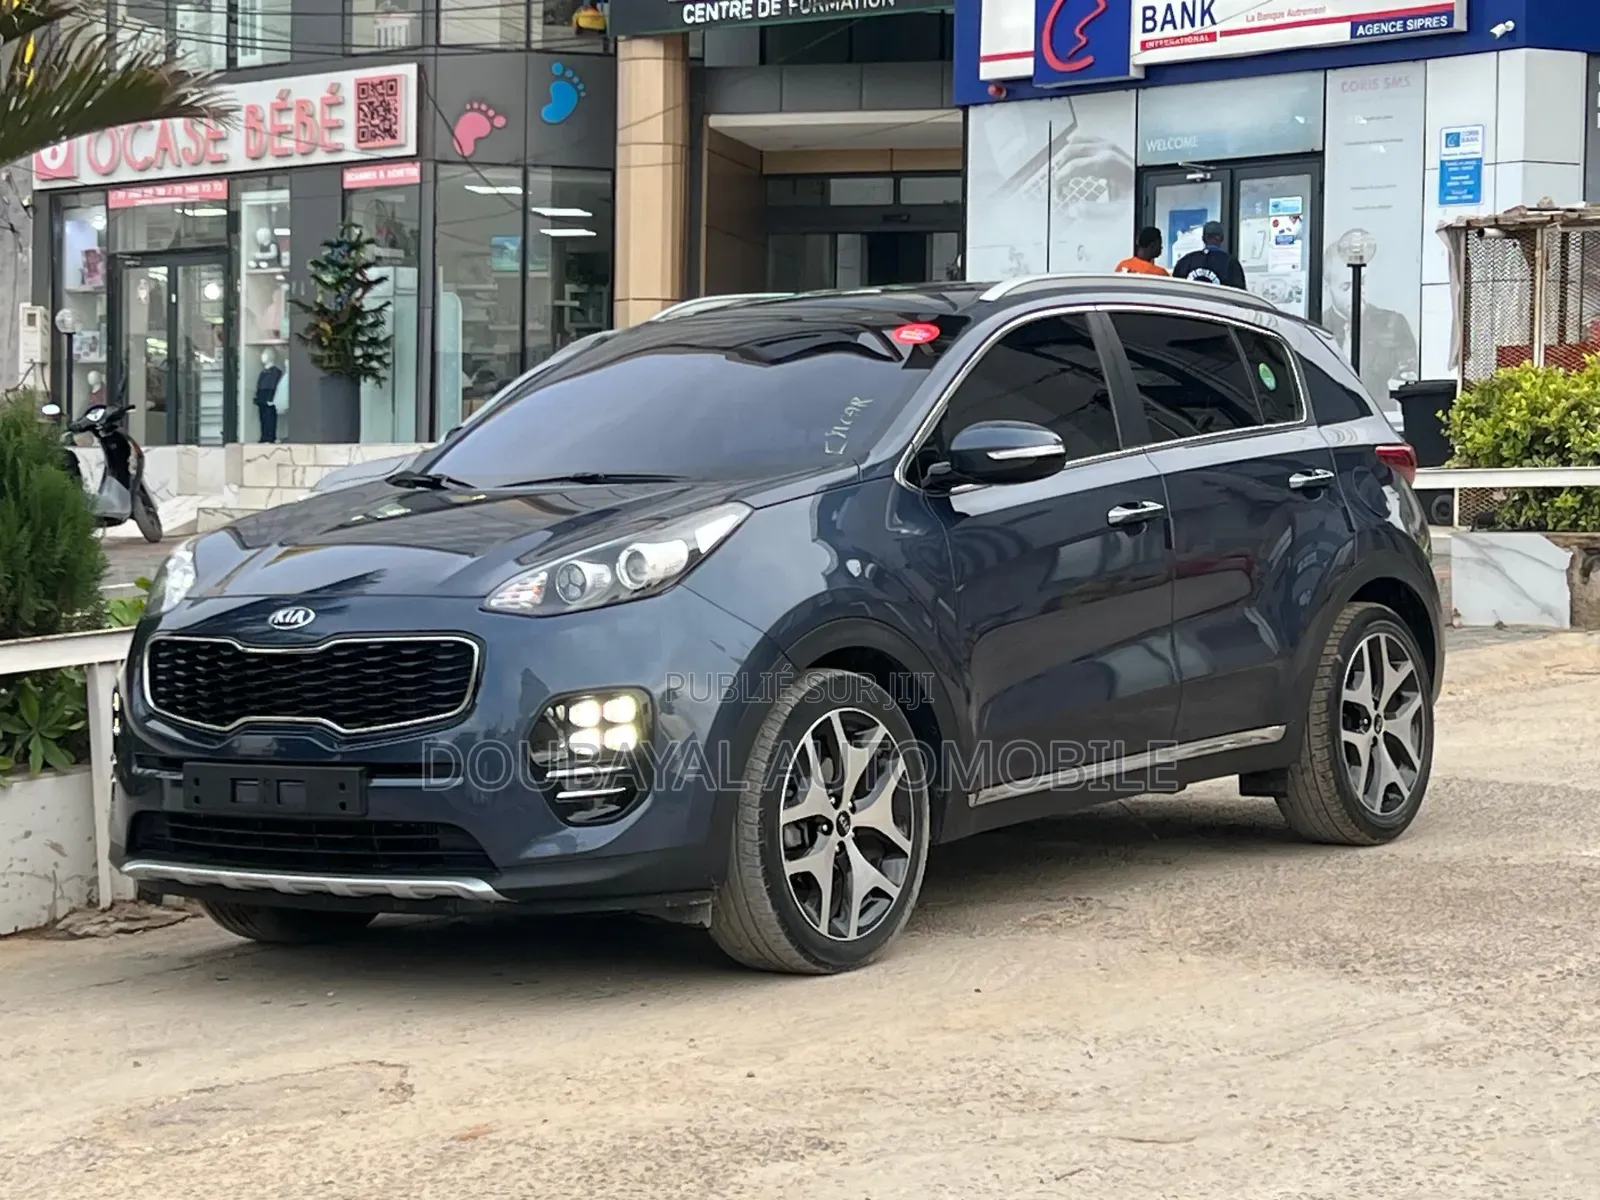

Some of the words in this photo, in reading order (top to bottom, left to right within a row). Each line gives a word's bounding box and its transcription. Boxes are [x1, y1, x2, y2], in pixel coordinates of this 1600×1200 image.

[682, 0, 753, 24] CENTRE
[757, 0, 782, 18] DE
[1142, 0, 1217, 34] BANK
[1356, 21, 1404, 37] AGENCE
[1406, 15, 1449, 31] SIPRES
[1383, 75, 1412, 91] SMS
[86, 118, 228, 176] OCASE
[245, 82, 345, 160] BÉBÉ
[1145, 136, 1199, 152] WELCOME
